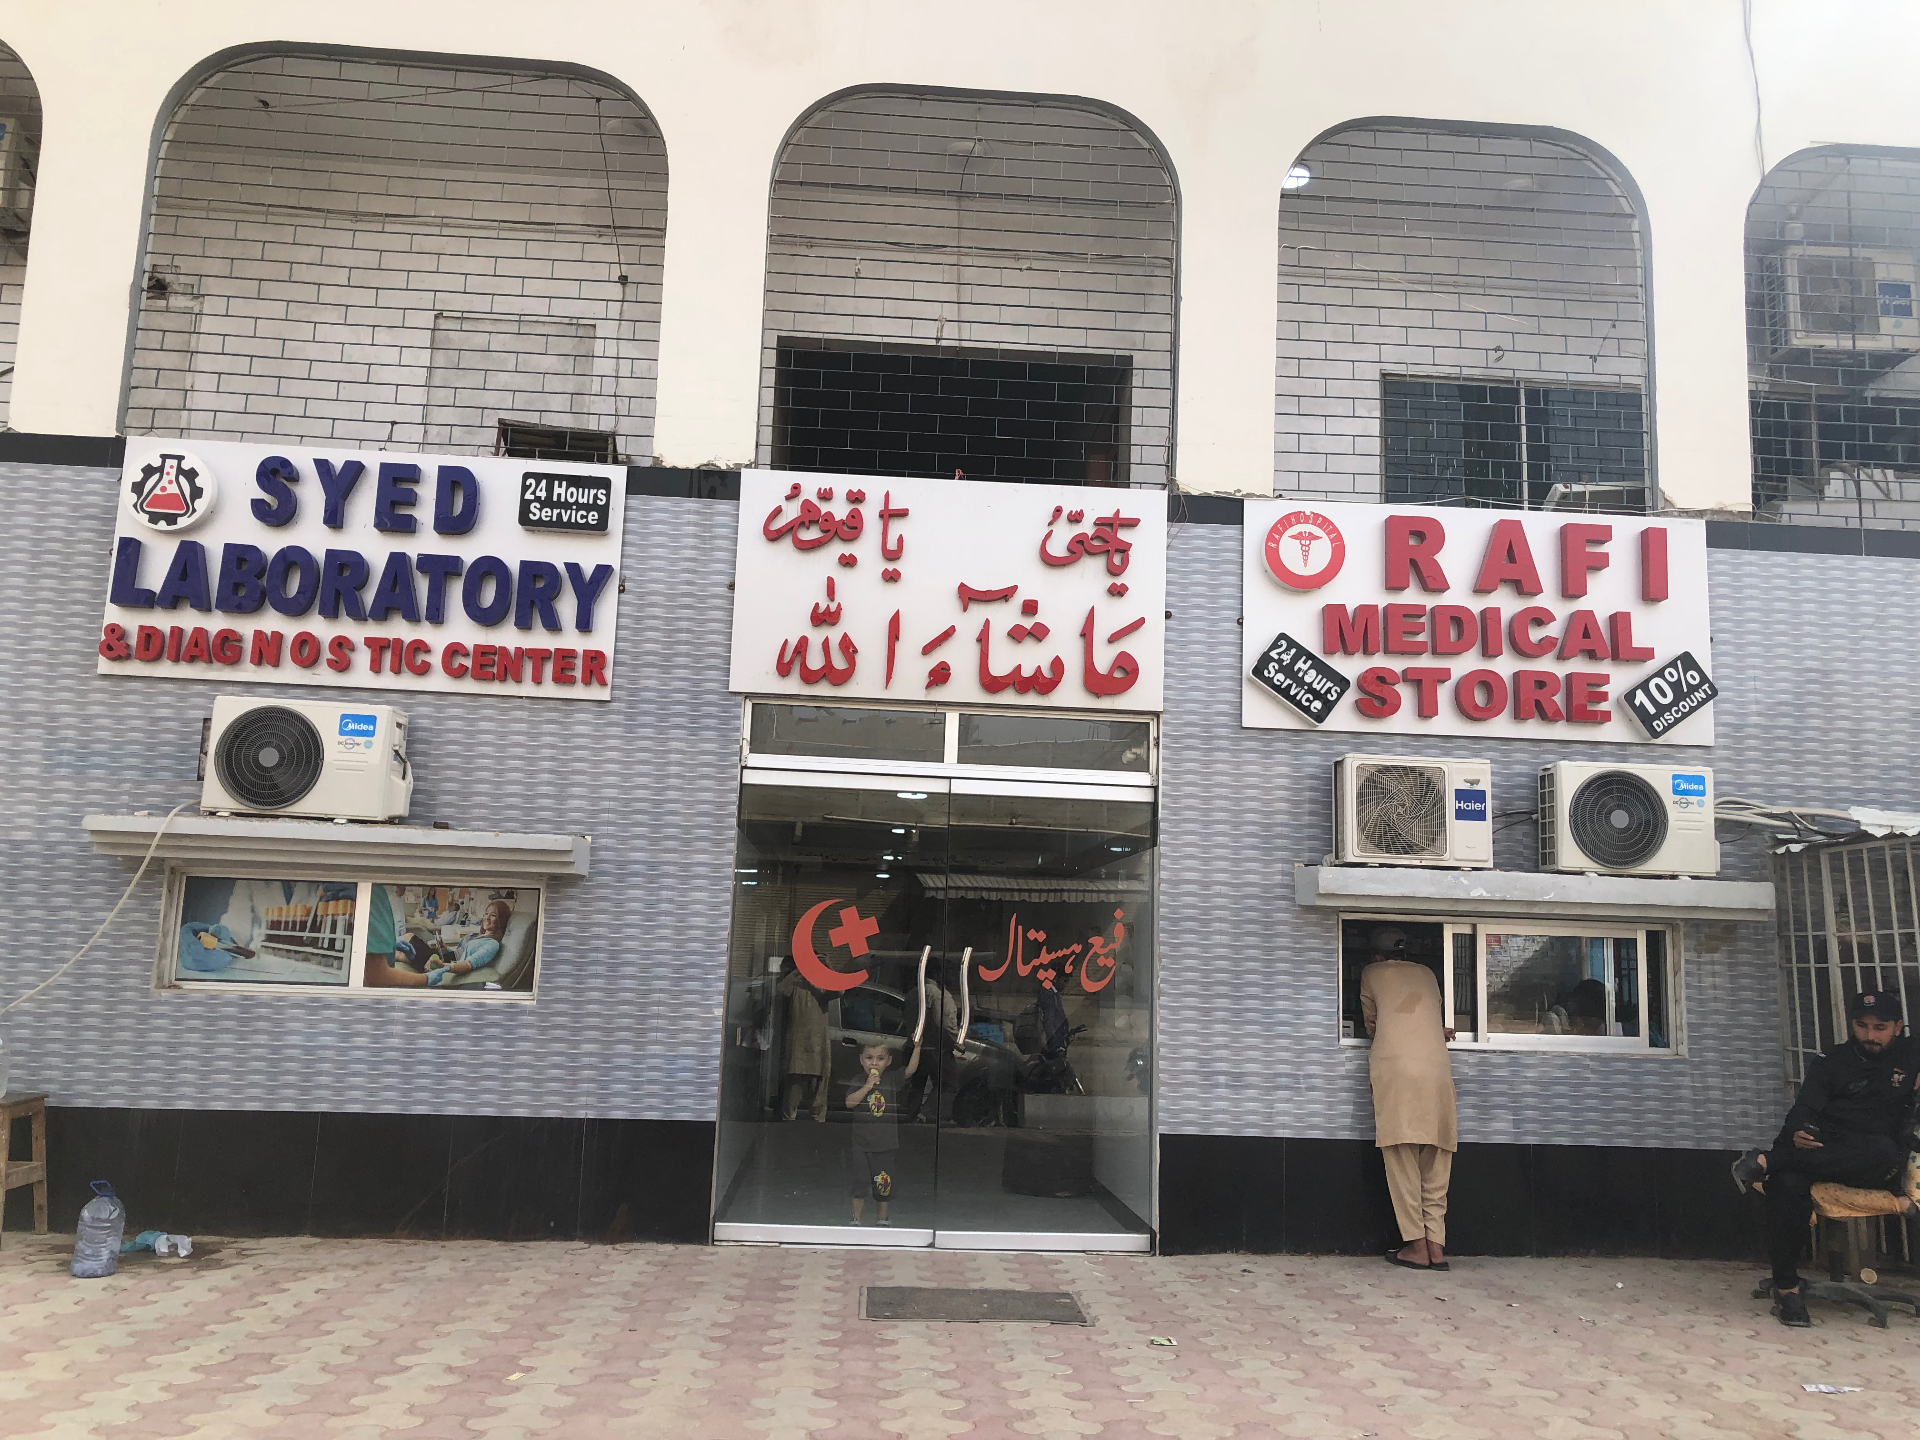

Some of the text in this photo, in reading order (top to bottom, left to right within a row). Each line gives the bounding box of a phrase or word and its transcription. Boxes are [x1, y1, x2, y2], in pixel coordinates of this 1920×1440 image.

[251, 455, 481, 535] SYED
[524, 478, 607, 506] 24 Hours
[528, 502, 599, 525] Service
[1384, 514, 1669, 603] RAFI
[109, 537, 614, 632] LABORATORY
[1322, 603, 1655, 662] MEDICAL
[441, 641, 609, 686] CENTER
[1263, 662, 1323, 712] Service
[1268, 640, 1341, 700] 24 Hours
[1634, 660, 1700, 715] 10%
[1356, 666, 1612, 724] STORE
[1652, 683, 1712, 732] DISCOUNT
[341, 719, 374, 731] Midea
[1455, 800, 1486, 811] Haier
[1674, 779, 1705, 791] Midea
